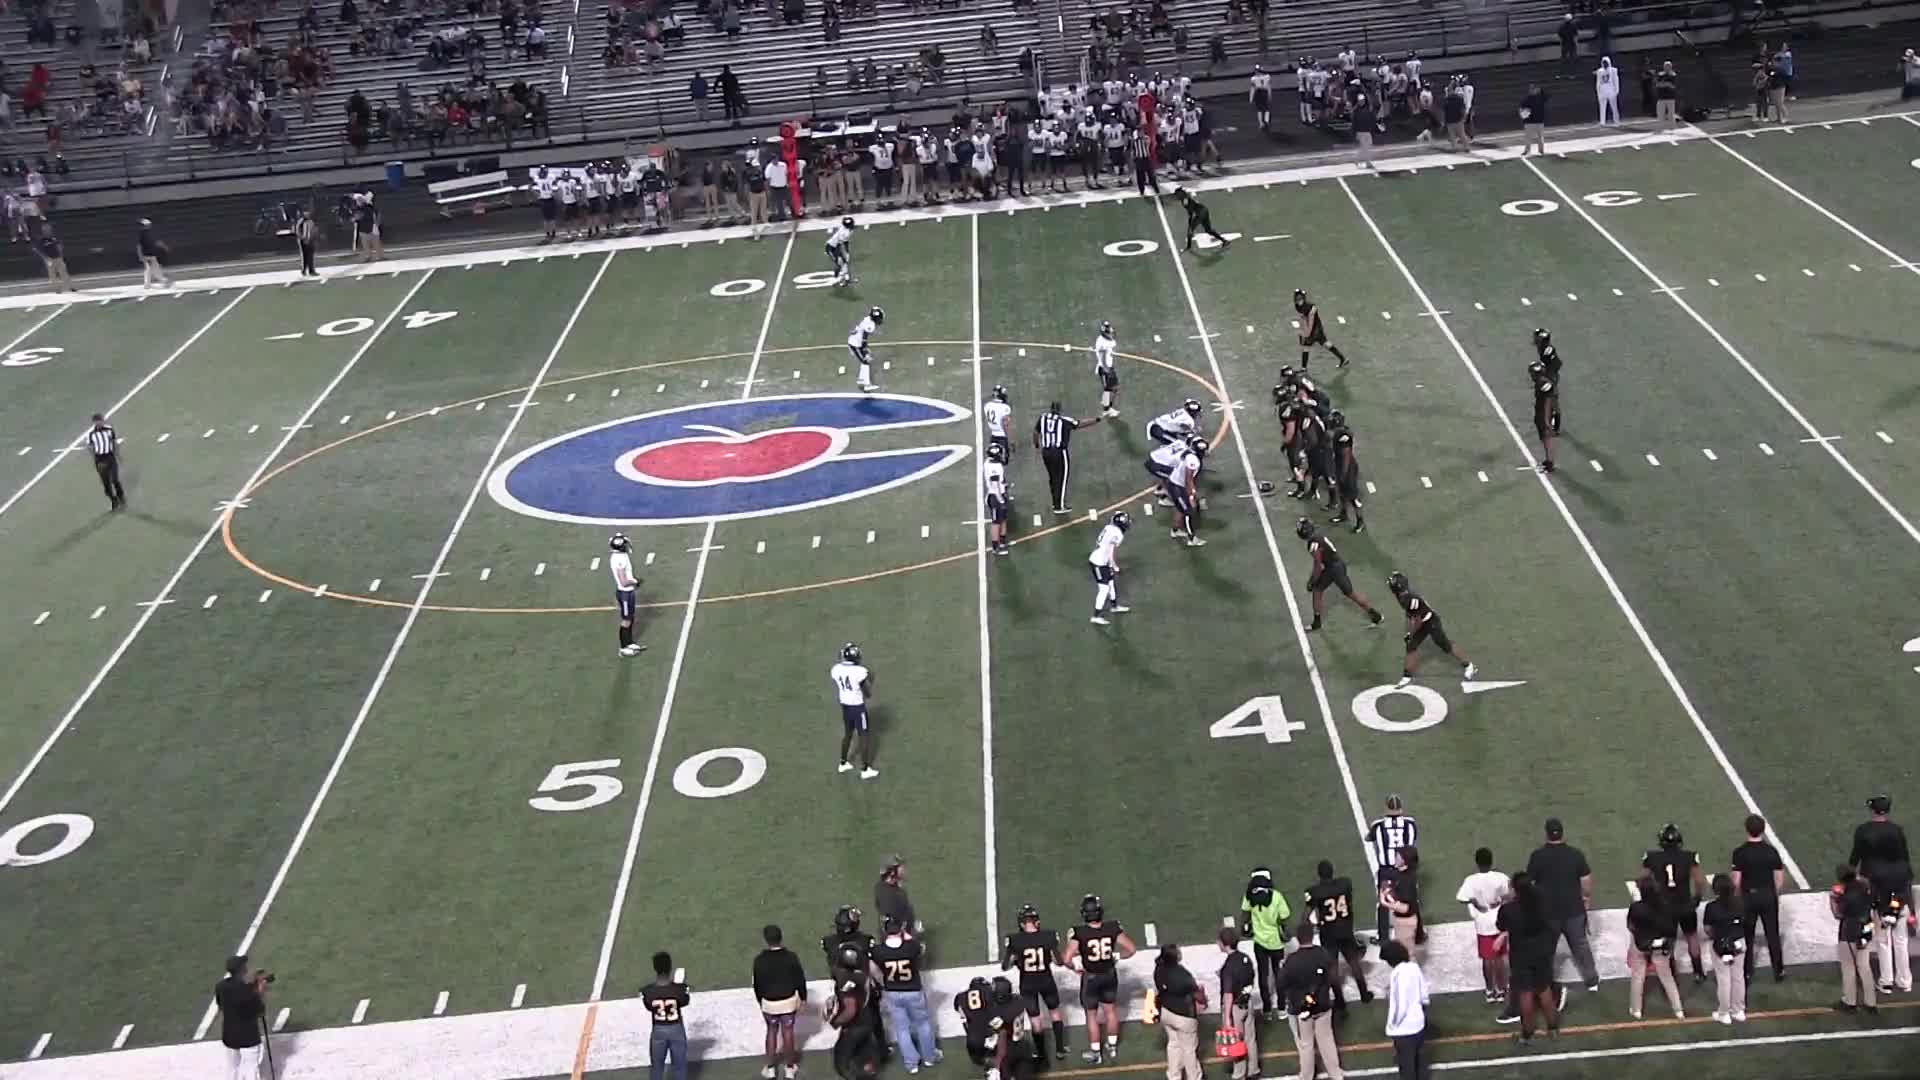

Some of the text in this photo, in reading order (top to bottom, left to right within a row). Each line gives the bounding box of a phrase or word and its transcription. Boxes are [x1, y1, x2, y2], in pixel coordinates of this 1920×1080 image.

[1664, 864, 1675, 887] 1
[1324, 894, 1348, 921] 34
[1023, 947, 1045, 971] 21
[1087, 937, 1112, 961] 36
[884, 959, 912, 981] 75
[651, 999, 679, 1021] 33
[967, 990, 982, 1010] 8
